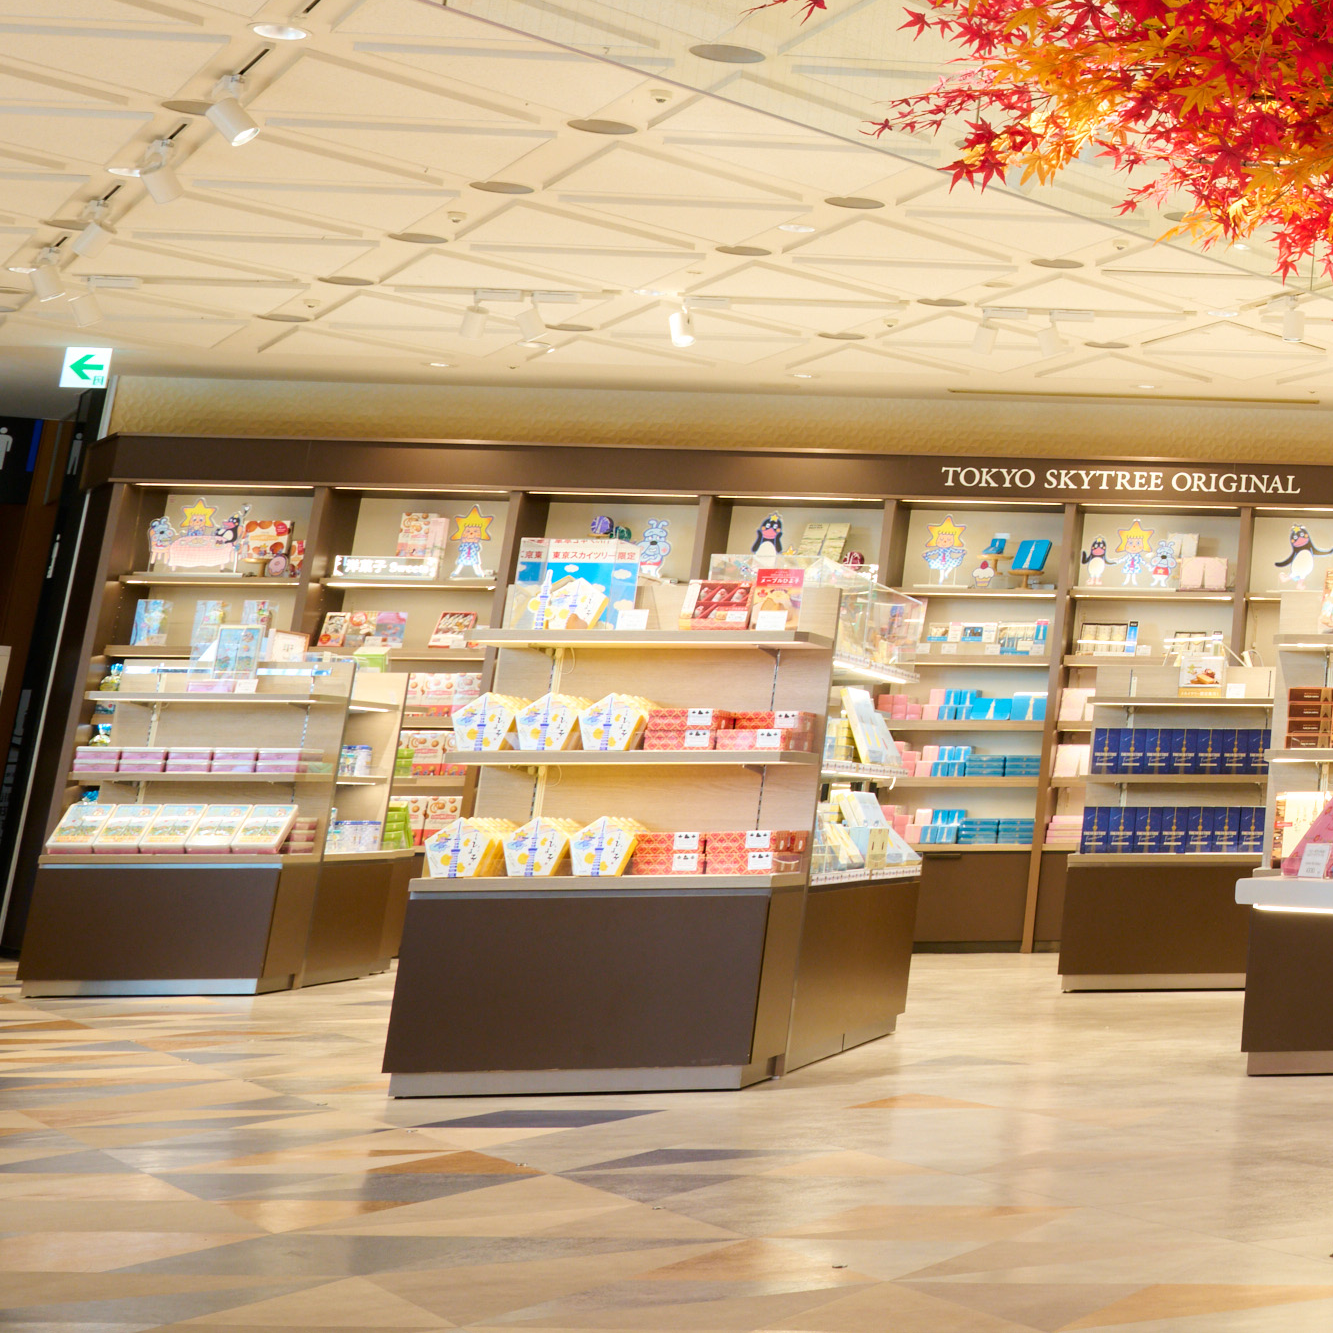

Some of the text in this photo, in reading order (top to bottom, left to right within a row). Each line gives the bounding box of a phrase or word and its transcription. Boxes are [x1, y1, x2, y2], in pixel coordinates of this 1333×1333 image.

[941, 467, 1301, 495] TOKYO SKYTREE ORIGINAL
